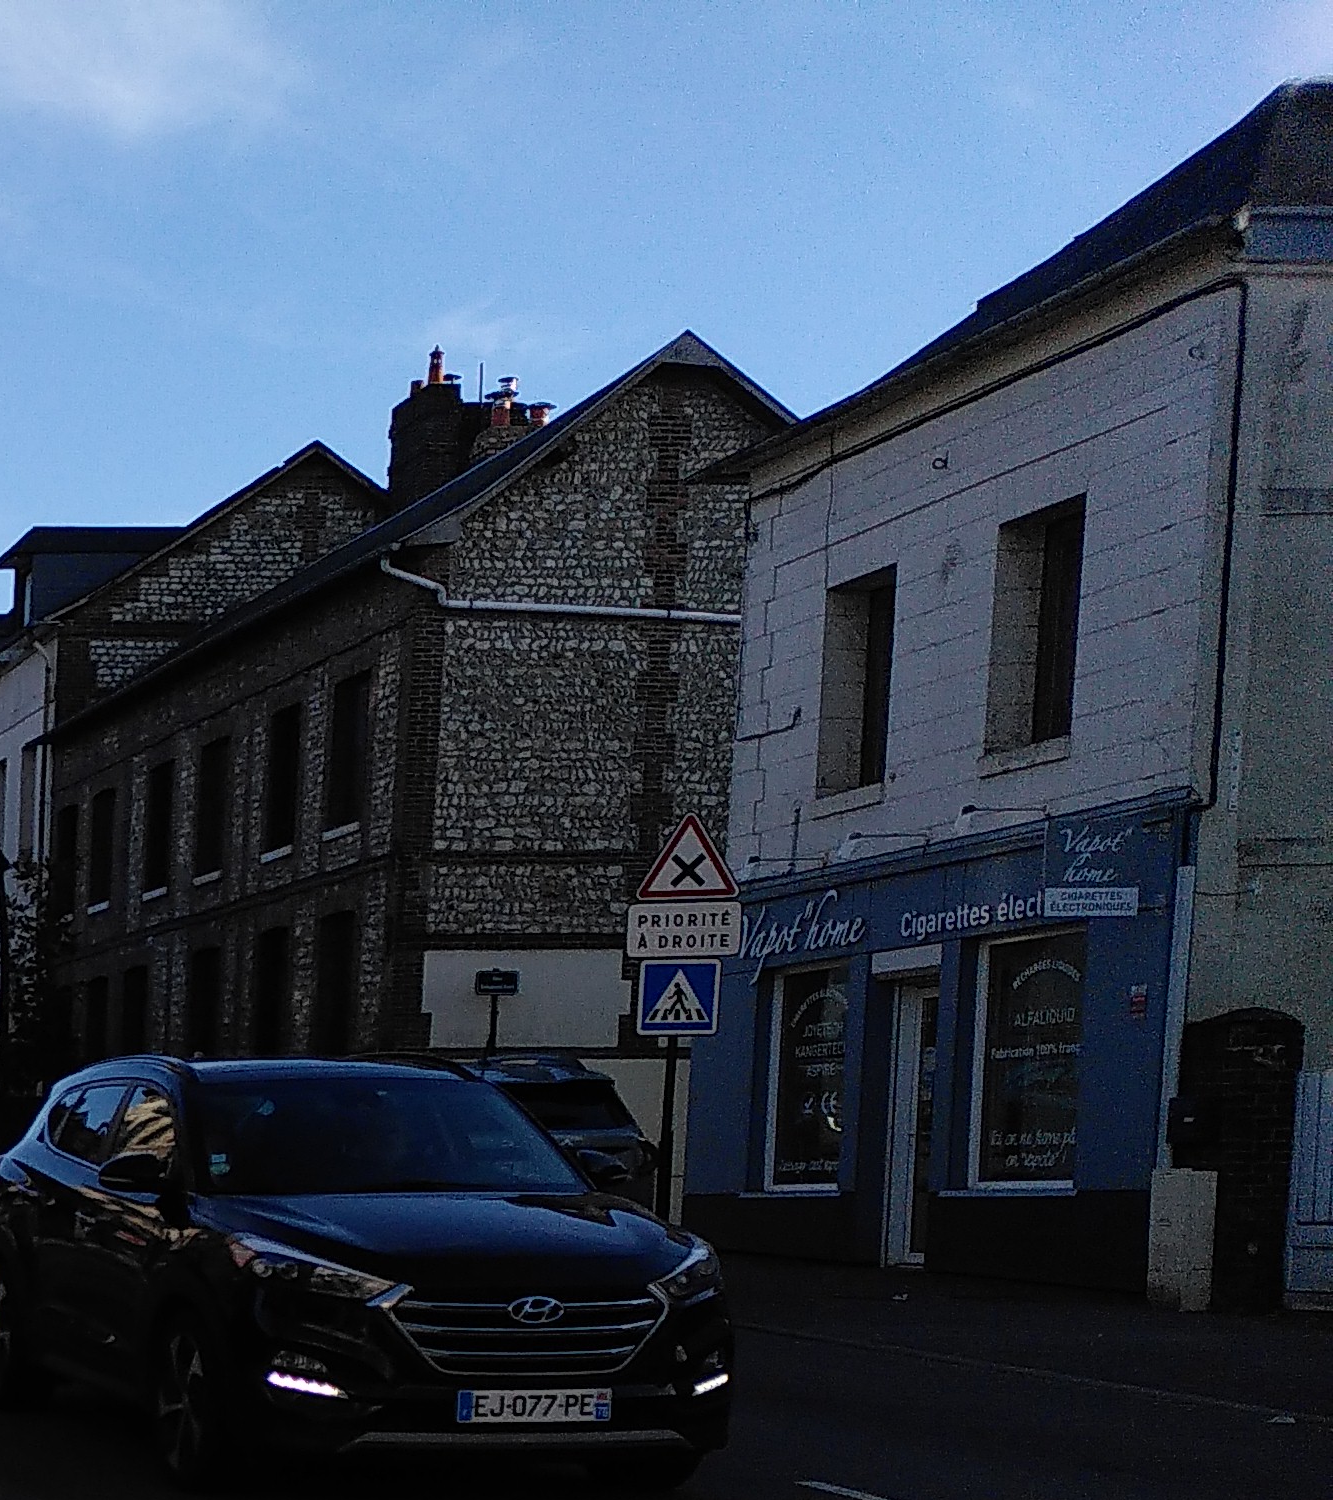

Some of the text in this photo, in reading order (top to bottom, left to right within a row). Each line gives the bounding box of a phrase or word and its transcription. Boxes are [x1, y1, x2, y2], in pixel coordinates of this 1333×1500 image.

[1062, 852, 1120, 883] home
[637, 910, 731, 928] PRIORITÉ
[900, 902, 991, 941] Cigarettes
[637, 932, 730, 949] À DROITE
[475, 1394, 594, 1417] EJ-077-PE
